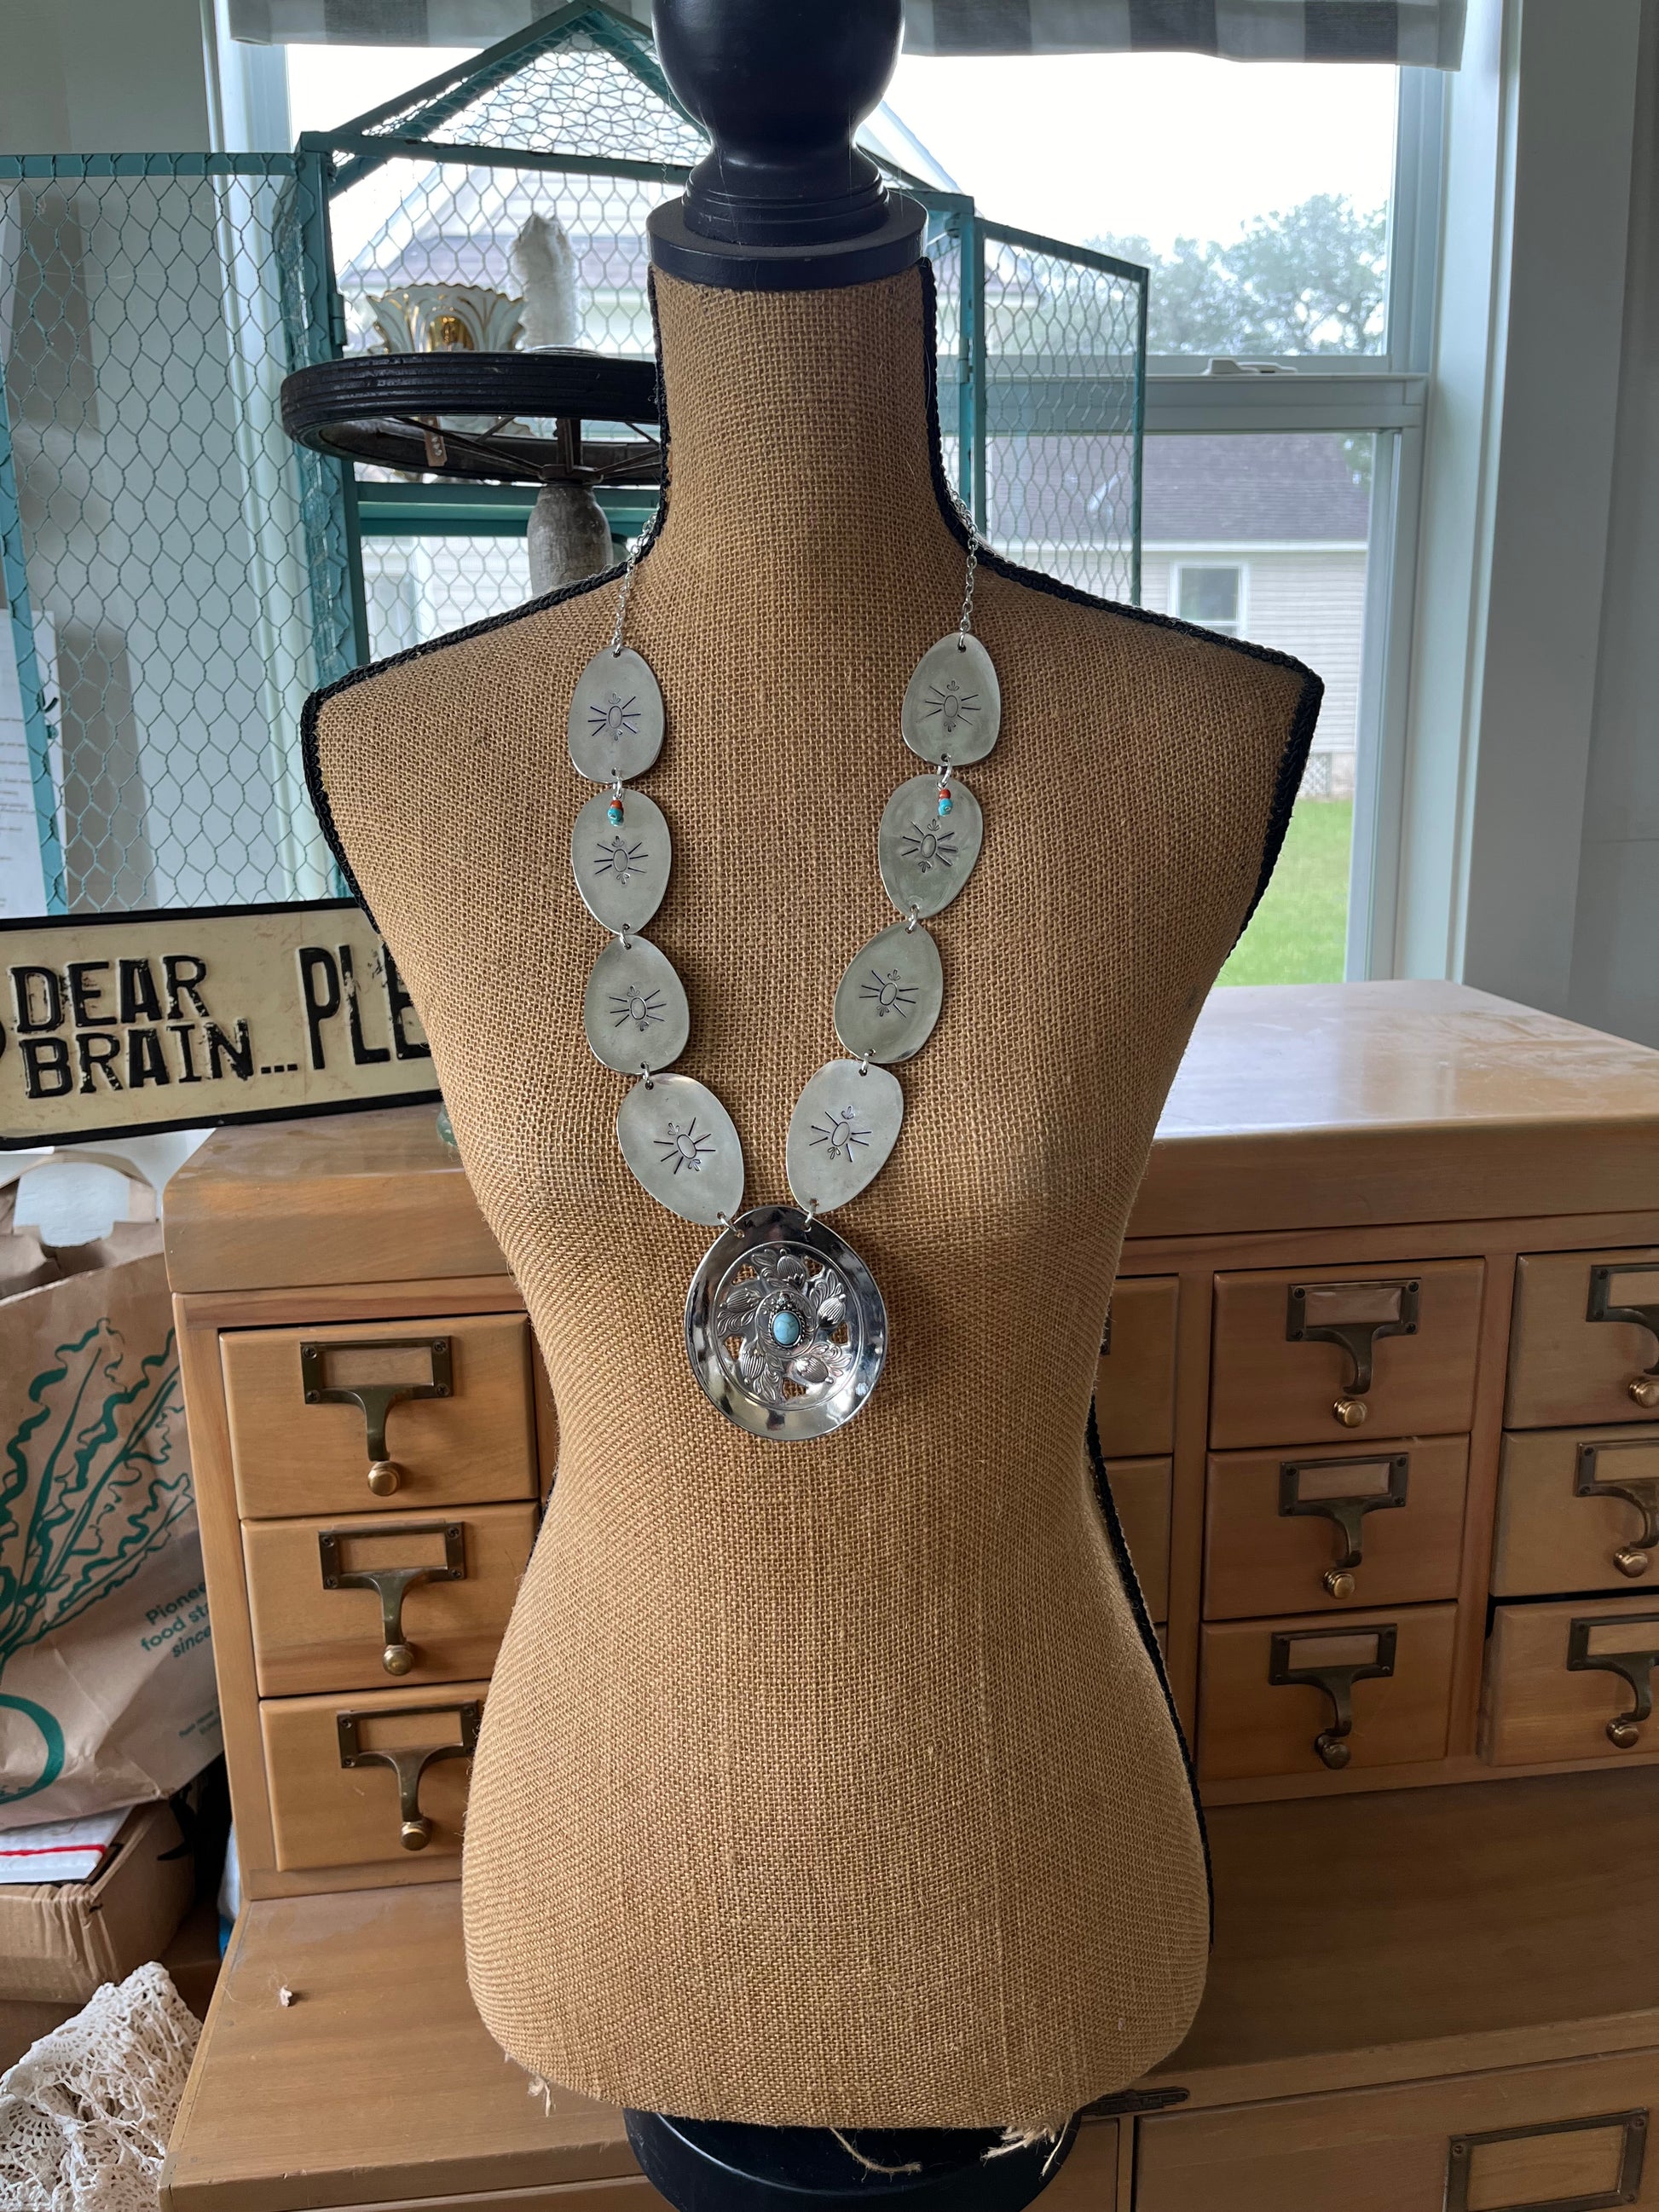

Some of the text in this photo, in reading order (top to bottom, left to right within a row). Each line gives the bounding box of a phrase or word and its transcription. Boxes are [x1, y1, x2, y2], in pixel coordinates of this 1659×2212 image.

[12, 956, 210, 1033] DEAR
[21, 1019, 298, 1099] BRAIN...
[141, 1615, 186, 1651] food
